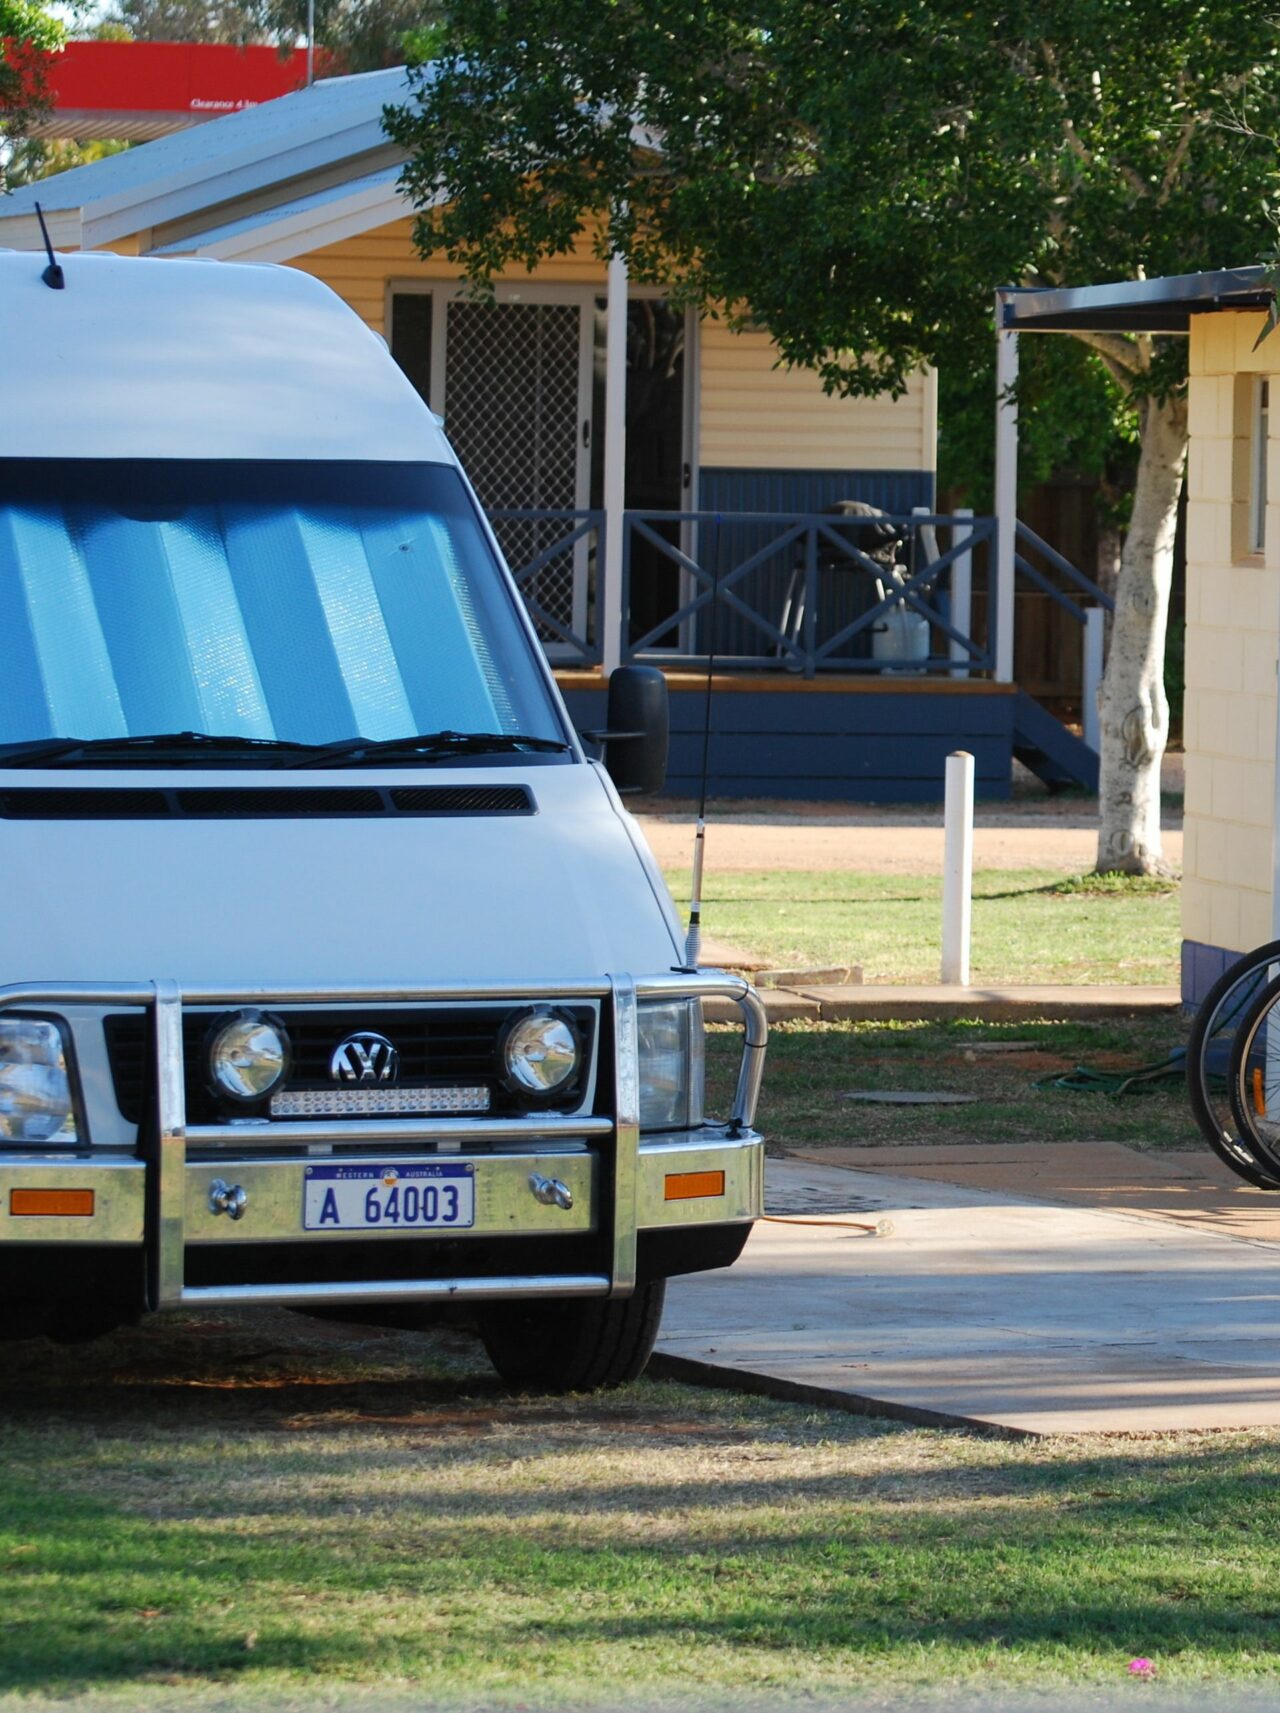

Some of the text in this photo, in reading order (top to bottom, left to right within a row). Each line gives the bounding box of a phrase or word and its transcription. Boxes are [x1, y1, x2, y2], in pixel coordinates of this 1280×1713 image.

[190, 98, 234, 109] Clearance
[335, 1170, 444, 1179] WESTERN AUSTRALIA
[319, 1184, 460, 1224] A 64003
